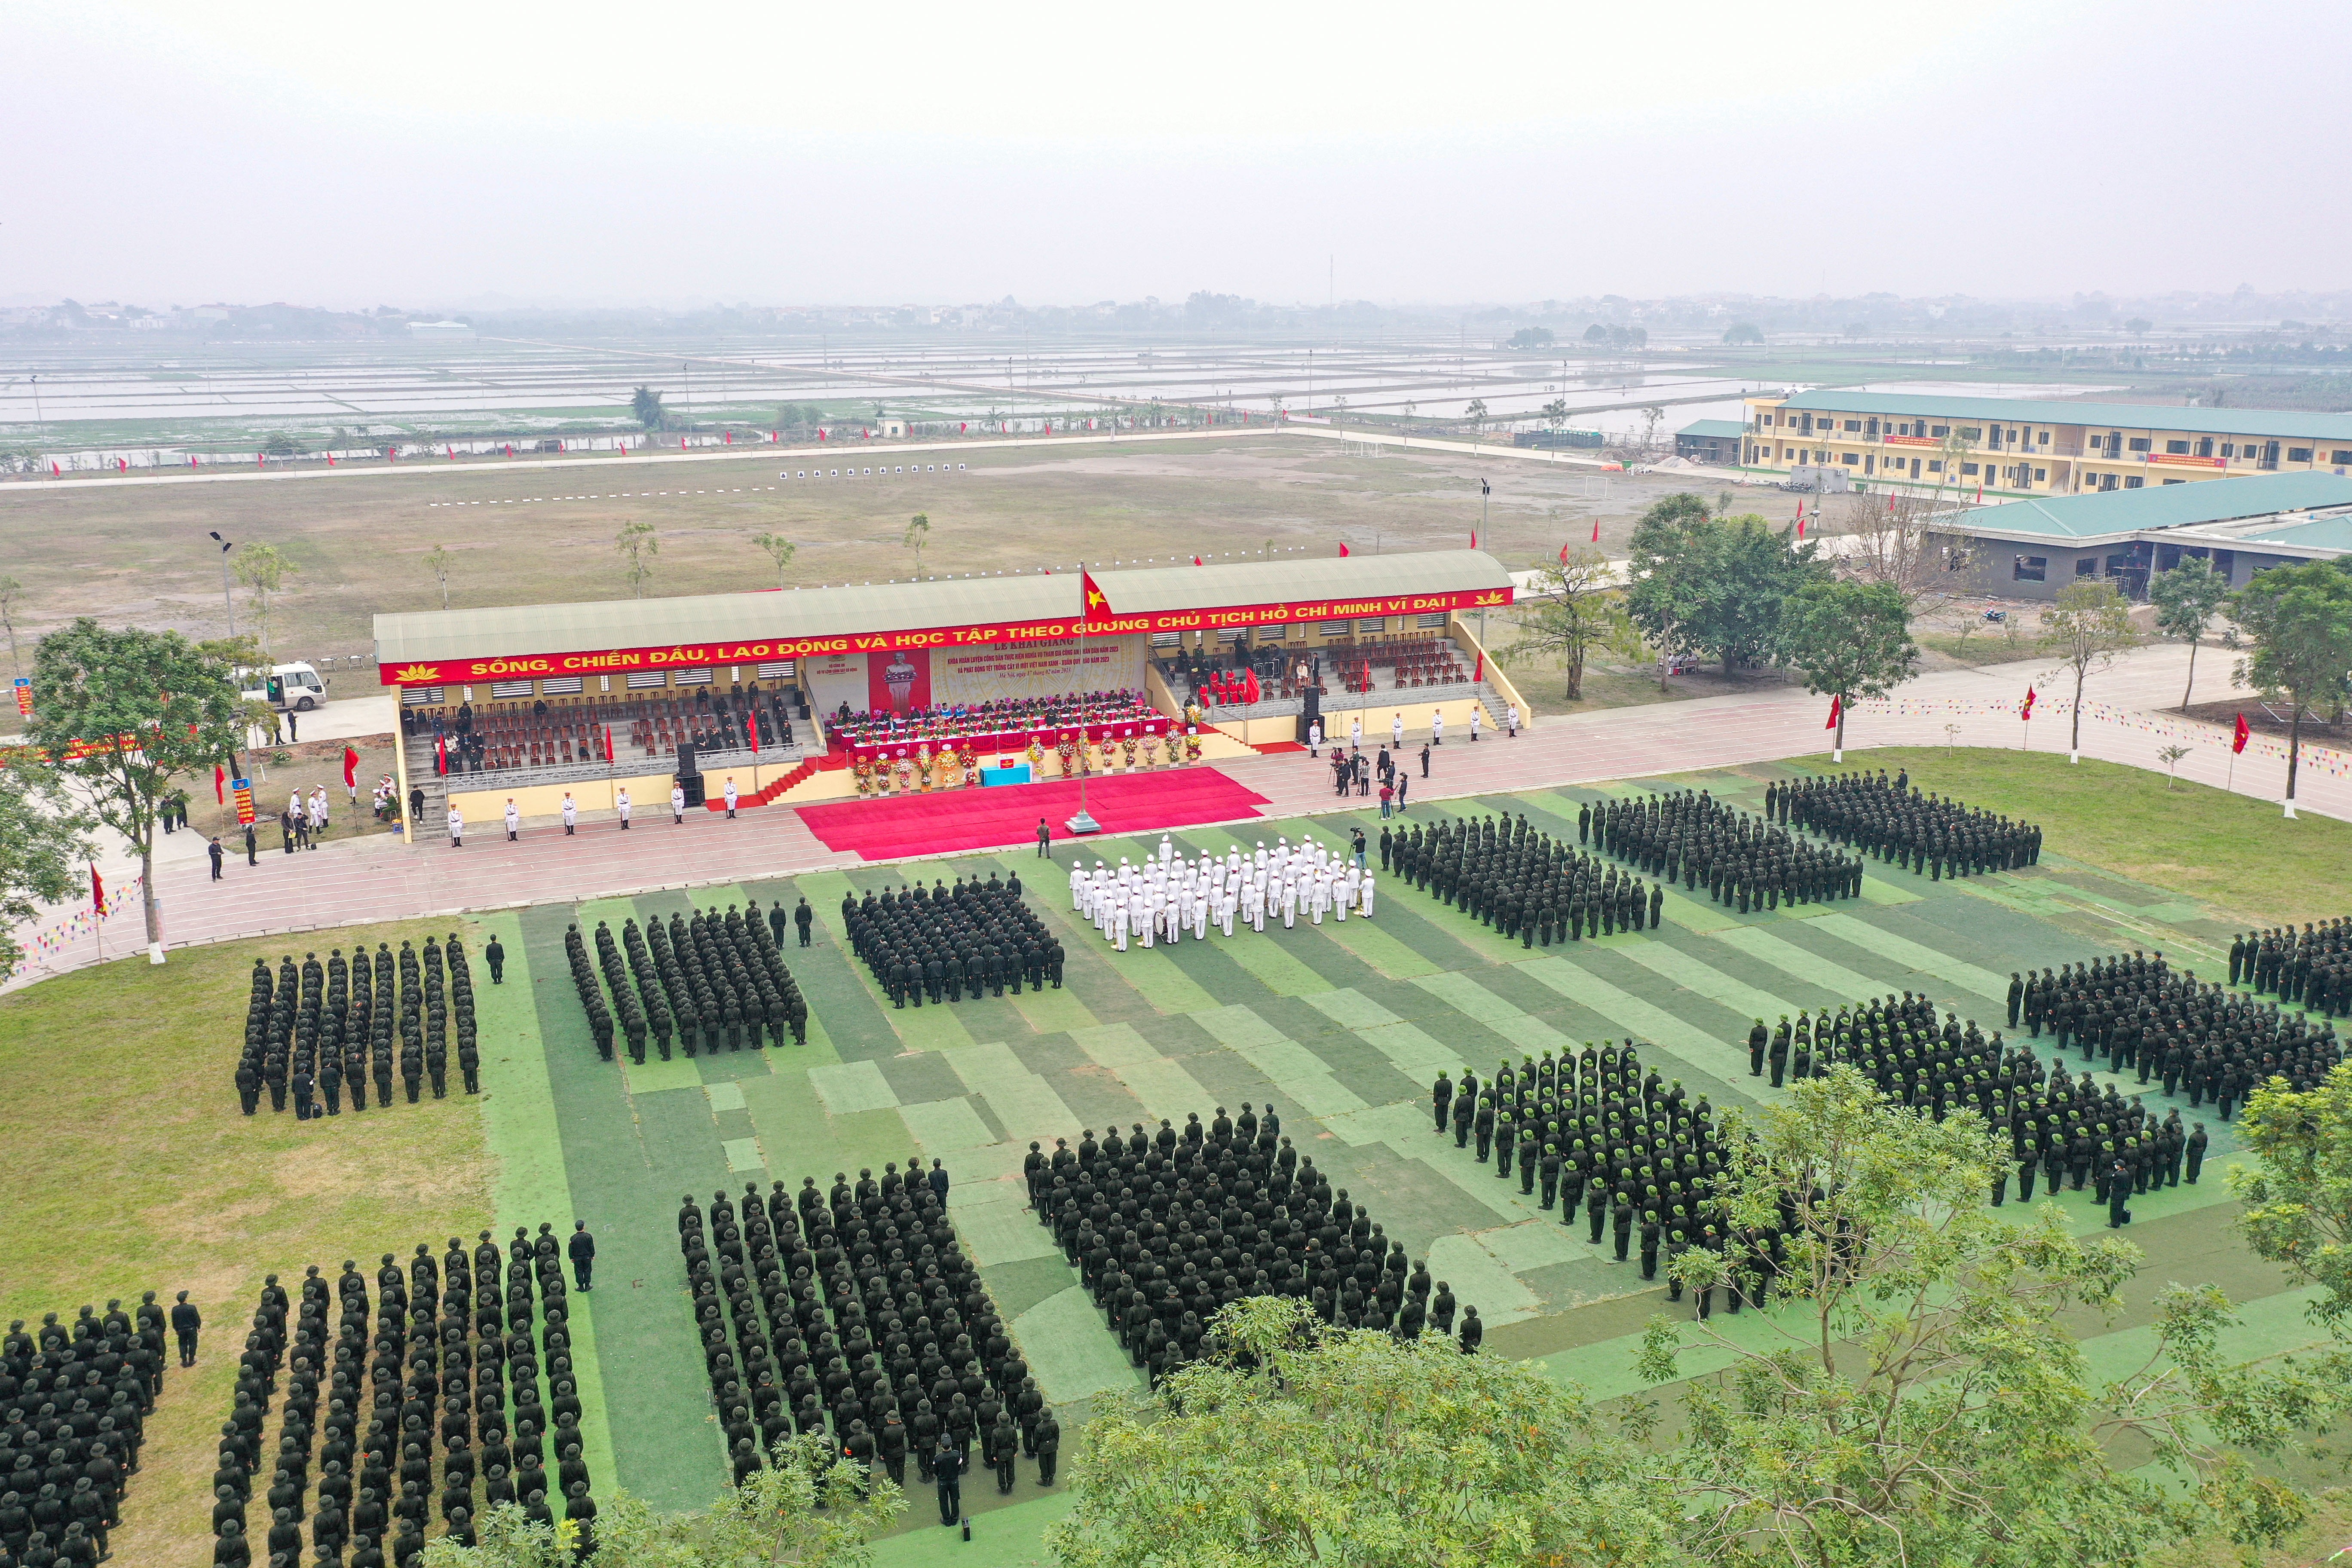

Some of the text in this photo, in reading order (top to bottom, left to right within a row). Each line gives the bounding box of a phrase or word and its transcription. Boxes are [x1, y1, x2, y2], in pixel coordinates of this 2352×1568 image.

[471, 657, 555, 675] SỐNG,
[564, 649, 640, 668] CHIẾN
[649, 646, 710, 663] ĐẤU,
[718, 645, 769, 658] LAO
[777, 639, 847, 656] ĐỘNG
[855, 634, 888, 649] VÀ
[896, 632, 944, 648] HỌC
[952, 628, 998, 644] TẬP
[1006, 625, 1064, 638] THEO
[1157, 611, 1200, 628] CHỦ
[1208, 611, 1254, 626] TỊCH
[1260, 603, 1288, 620] HỒ
[1295, 603, 1328, 617] CHÍ
[1333, 602, 1381, 615] MINH
[1387, 597, 1408, 610] VĨ
[1413, 597, 1446, 610] ĐẠI
